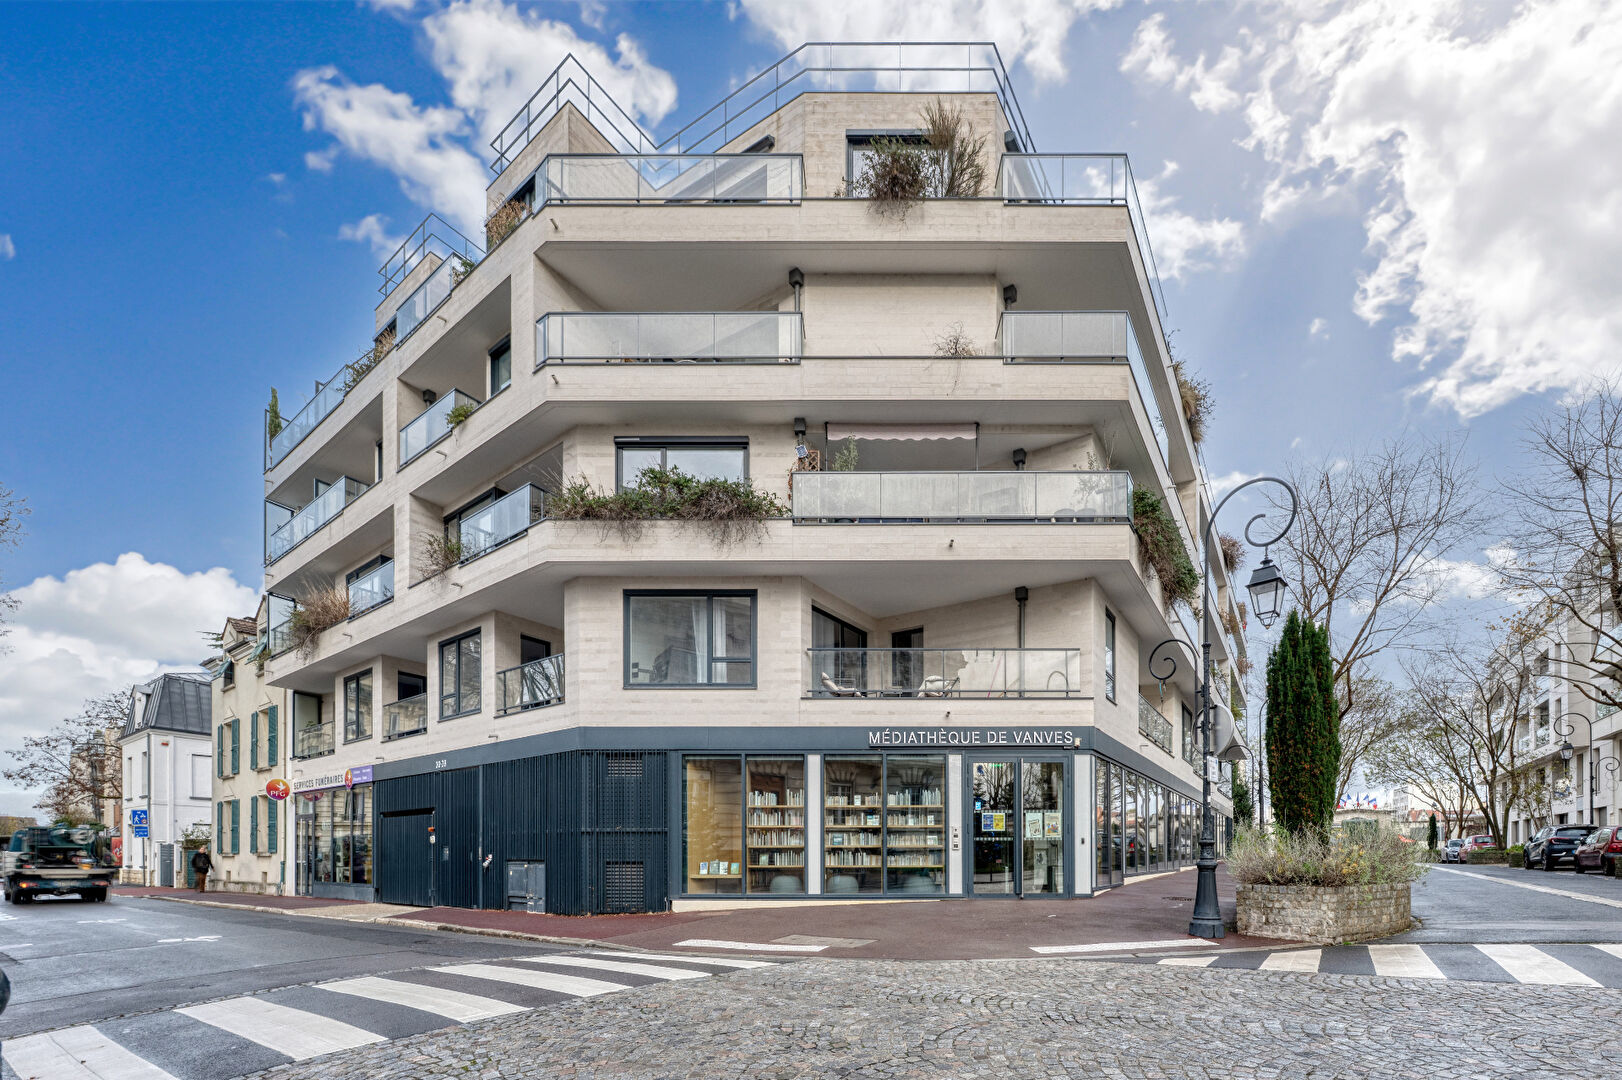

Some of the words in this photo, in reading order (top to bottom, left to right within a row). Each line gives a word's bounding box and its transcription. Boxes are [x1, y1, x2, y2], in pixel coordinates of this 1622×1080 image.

[868, 728, 981, 745] MÉDIATHÈQUE
[987, 731, 1007, 744] DE
[1013, 731, 1073, 744] VANVES
[293, 779, 314, 790] SERVICES
[315, 774, 344, 787] FUNÉRAIRES
